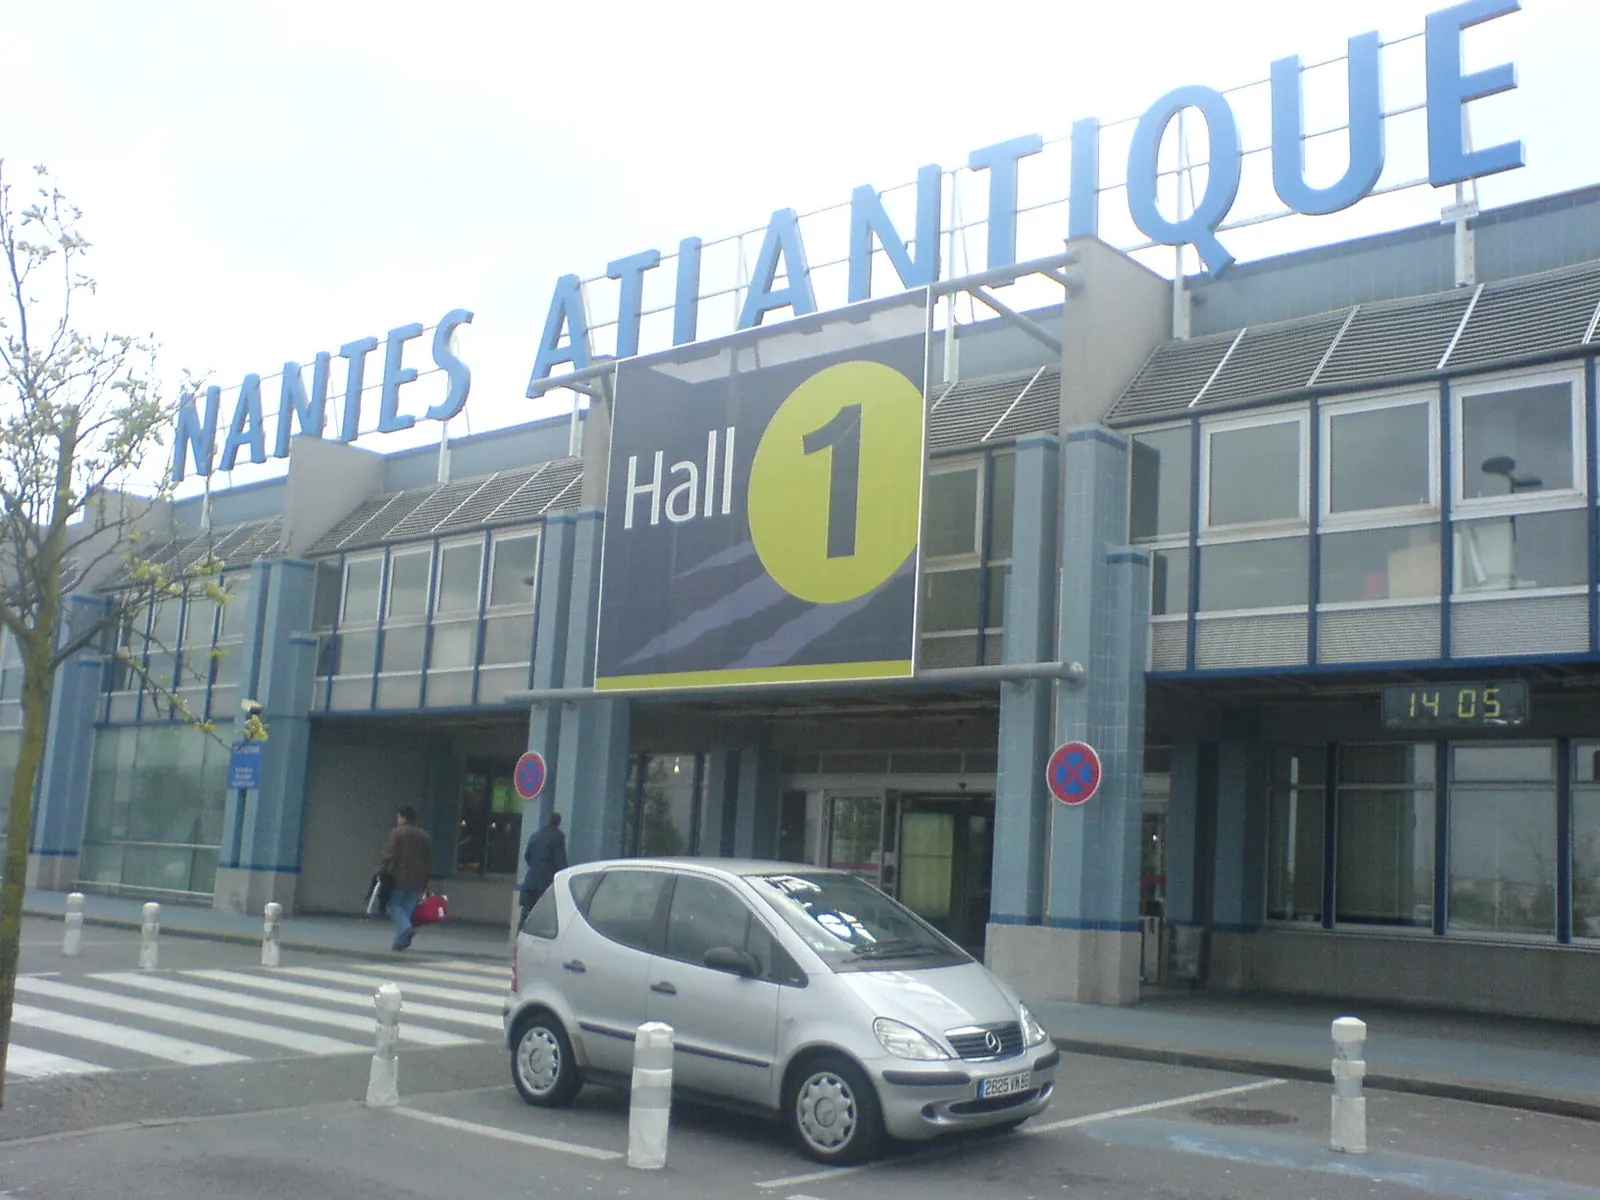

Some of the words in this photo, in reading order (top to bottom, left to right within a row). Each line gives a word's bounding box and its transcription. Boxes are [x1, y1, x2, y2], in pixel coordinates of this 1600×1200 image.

[172, 308, 474, 482] NANTES
[624, 426, 735, 529] Hall
[802, 402, 862, 559] 1
[1410, 692, 1440, 717] 14
[1458, 689, 1500, 718] 05
